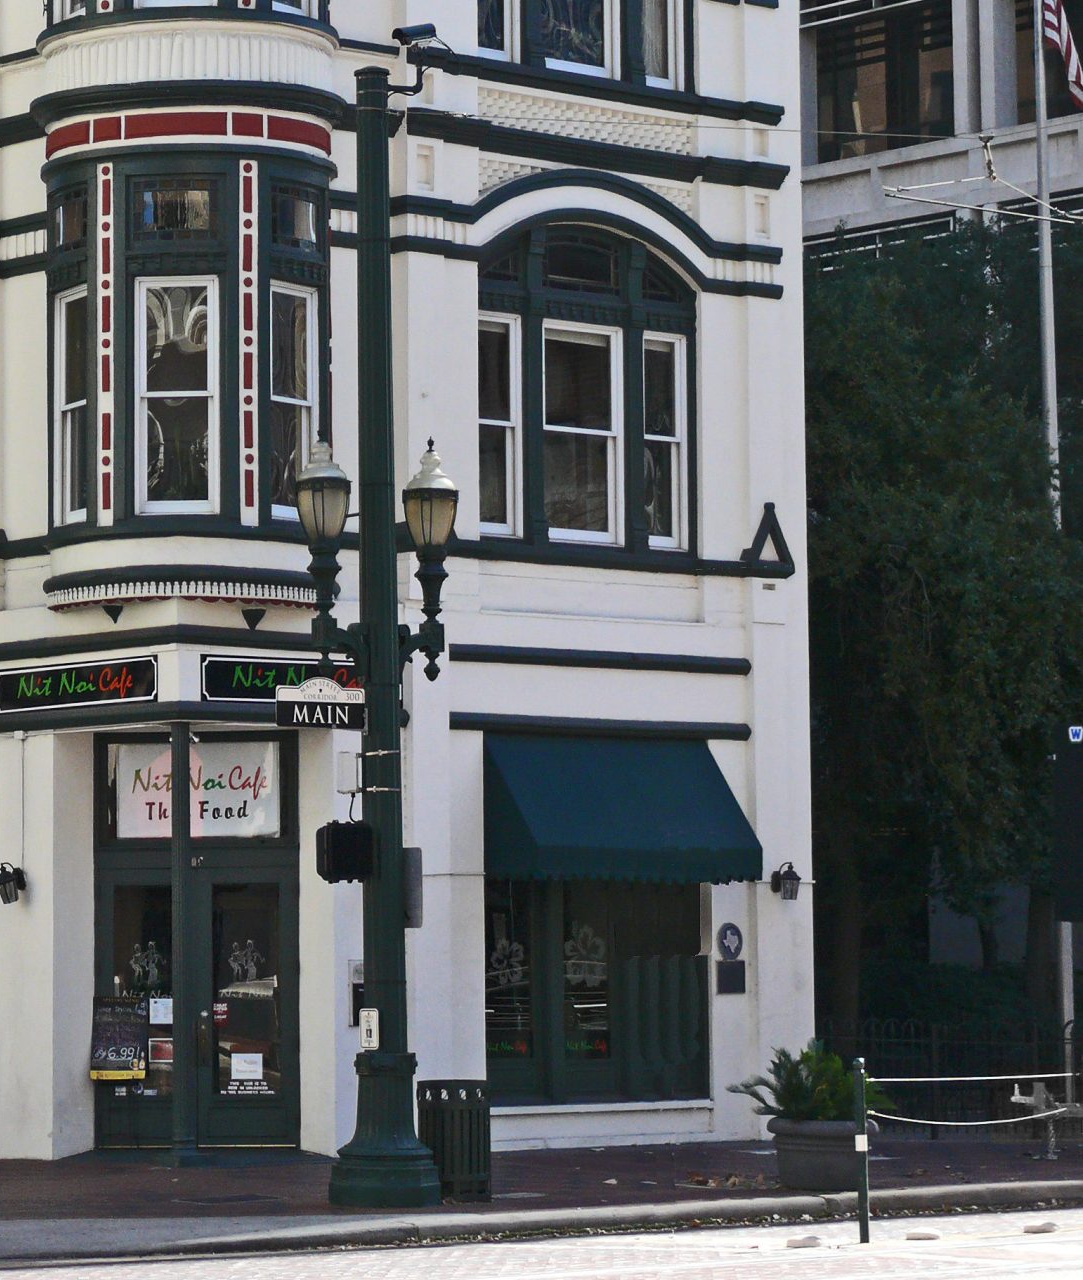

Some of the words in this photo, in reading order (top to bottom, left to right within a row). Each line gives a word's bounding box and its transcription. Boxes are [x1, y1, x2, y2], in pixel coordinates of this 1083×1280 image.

[17, 673, 52, 699] Nit
[58, 670, 96, 697] Noi
[99, 666, 134, 699] Cafe
[232, 664, 276, 688] Nit
[300, 681, 317, 693] MAIN
[318, 680, 341, 694] STREET
[345, 693, 360, 702] 300
[292, 703, 349, 725] MAIN
[132, 766, 172, 794] Nit
[228, 765, 268, 800] Cafe
[198, 800, 249, 820] Food
